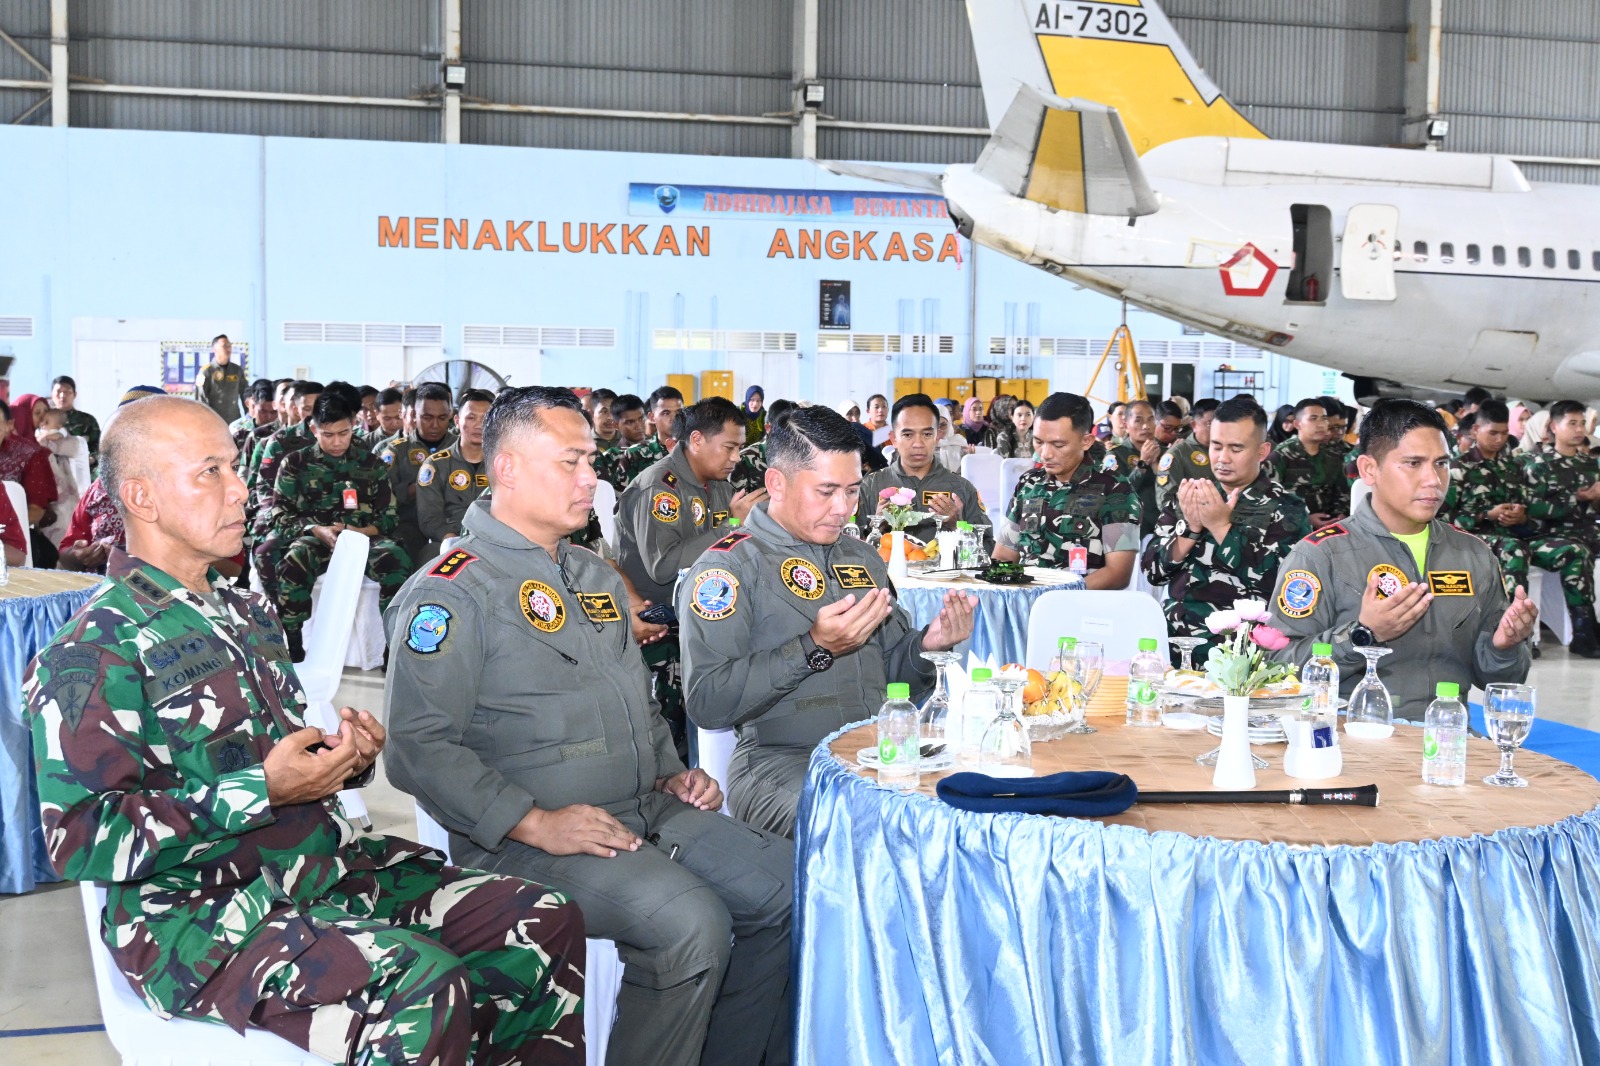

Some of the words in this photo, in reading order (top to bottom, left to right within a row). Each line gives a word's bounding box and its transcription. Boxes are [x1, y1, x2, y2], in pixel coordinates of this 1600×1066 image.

[1035, 3, 1148, 37] AI-7302
[703, 192, 832, 215] ADHIRAJASA
[853, 197, 949, 218] BUMANTA
[378, 215, 710, 256] MENAKLUKKAN
[767, 228, 963, 262] ANGKASA
[162, 658, 223, 691] KOMANG
